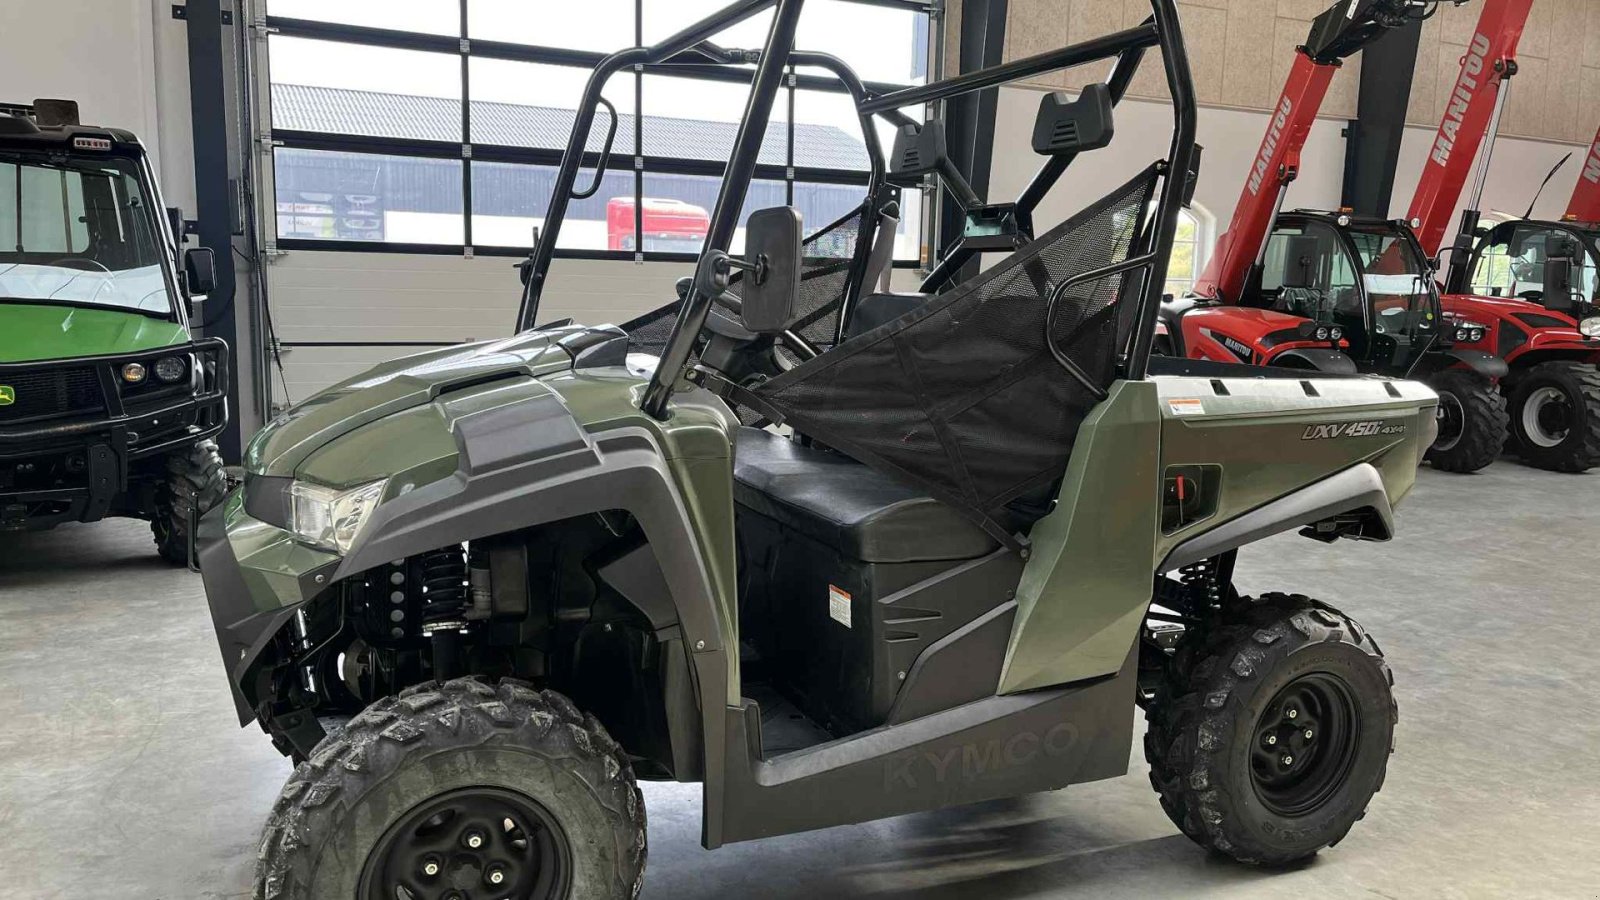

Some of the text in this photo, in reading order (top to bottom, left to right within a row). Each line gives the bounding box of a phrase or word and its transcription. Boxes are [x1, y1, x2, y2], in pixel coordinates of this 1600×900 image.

[1431, 32, 1490, 167] MANITOU
[1248, 95, 1292, 196] MANITOU
[1224, 337, 1251, 357] MANITOU
[1301, 424, 1347, 440] UXV
[1344, 420, 1383, 437] 450i
[884, 722, 1079, 794] KYMCO
